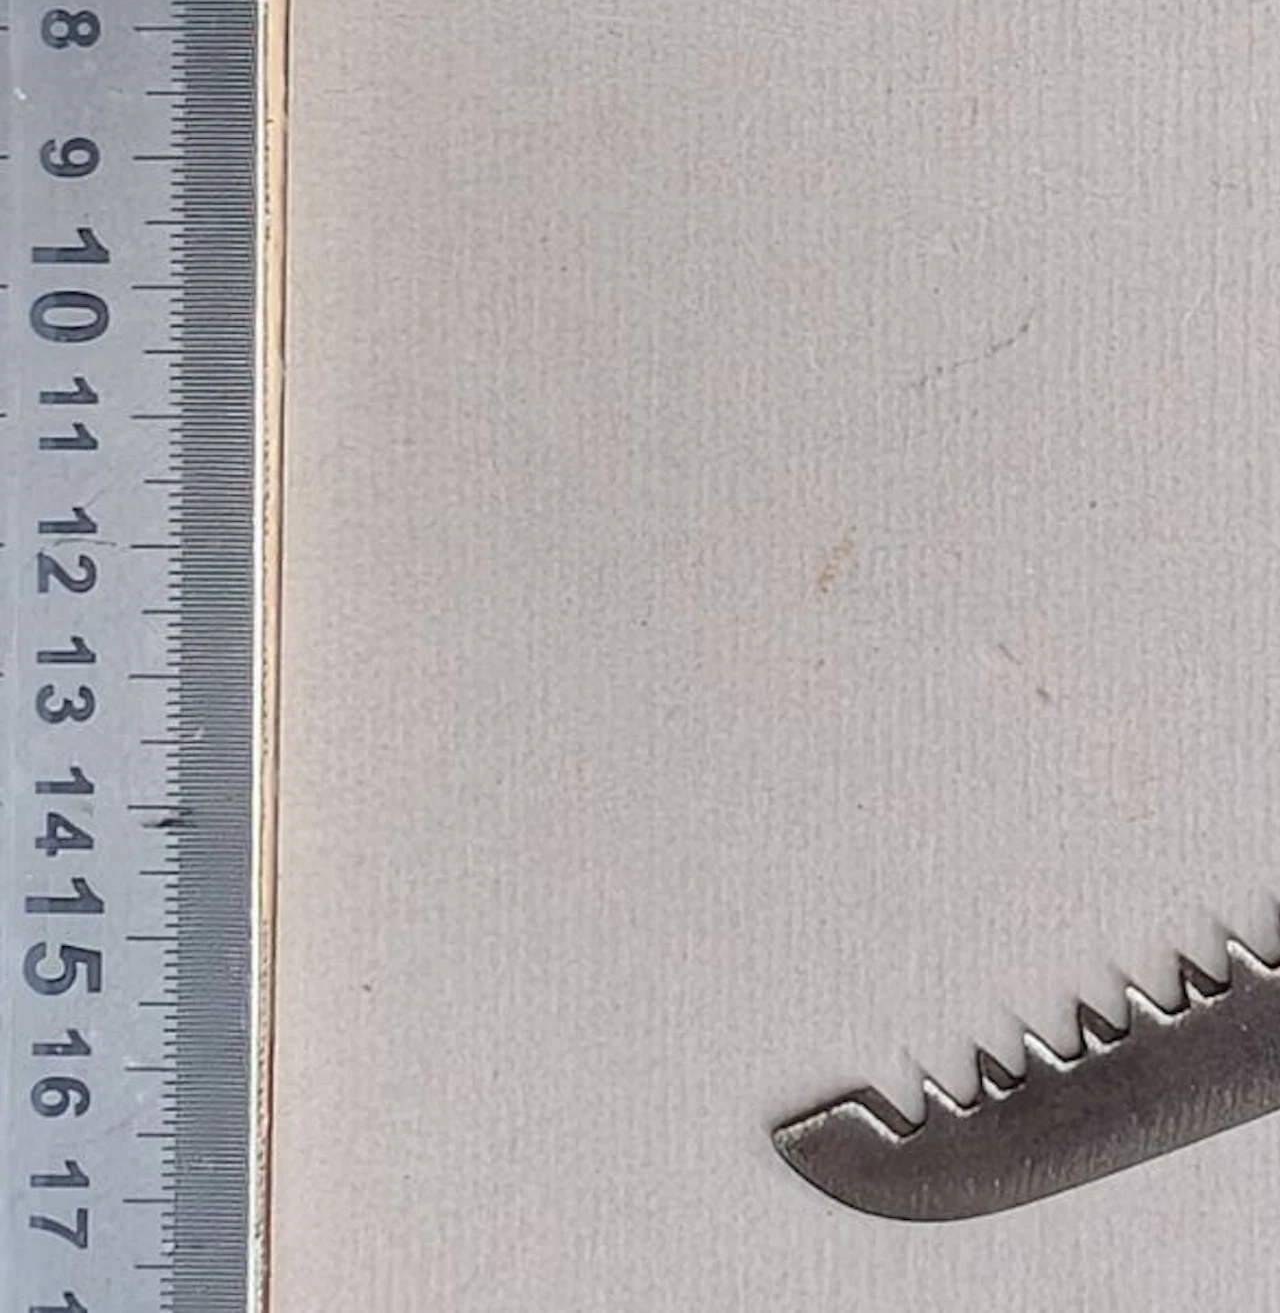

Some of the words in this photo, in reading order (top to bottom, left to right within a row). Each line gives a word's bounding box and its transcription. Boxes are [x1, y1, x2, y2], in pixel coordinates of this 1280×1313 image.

[40, 8, 101, 49] 8
[39, 137, 100, 178] 9
[31, 228, 109, 342] 10
[40, 378, 98, 450] 11
[38, 507, 97, 593] 12
[37, 637, 95, 723] 13
[36, 767, 94, 856] 14
[27, 878, 104, 995] 15
[31, 1030, 91, 1116] 16
[30, 1160, 89, 1248] 17
